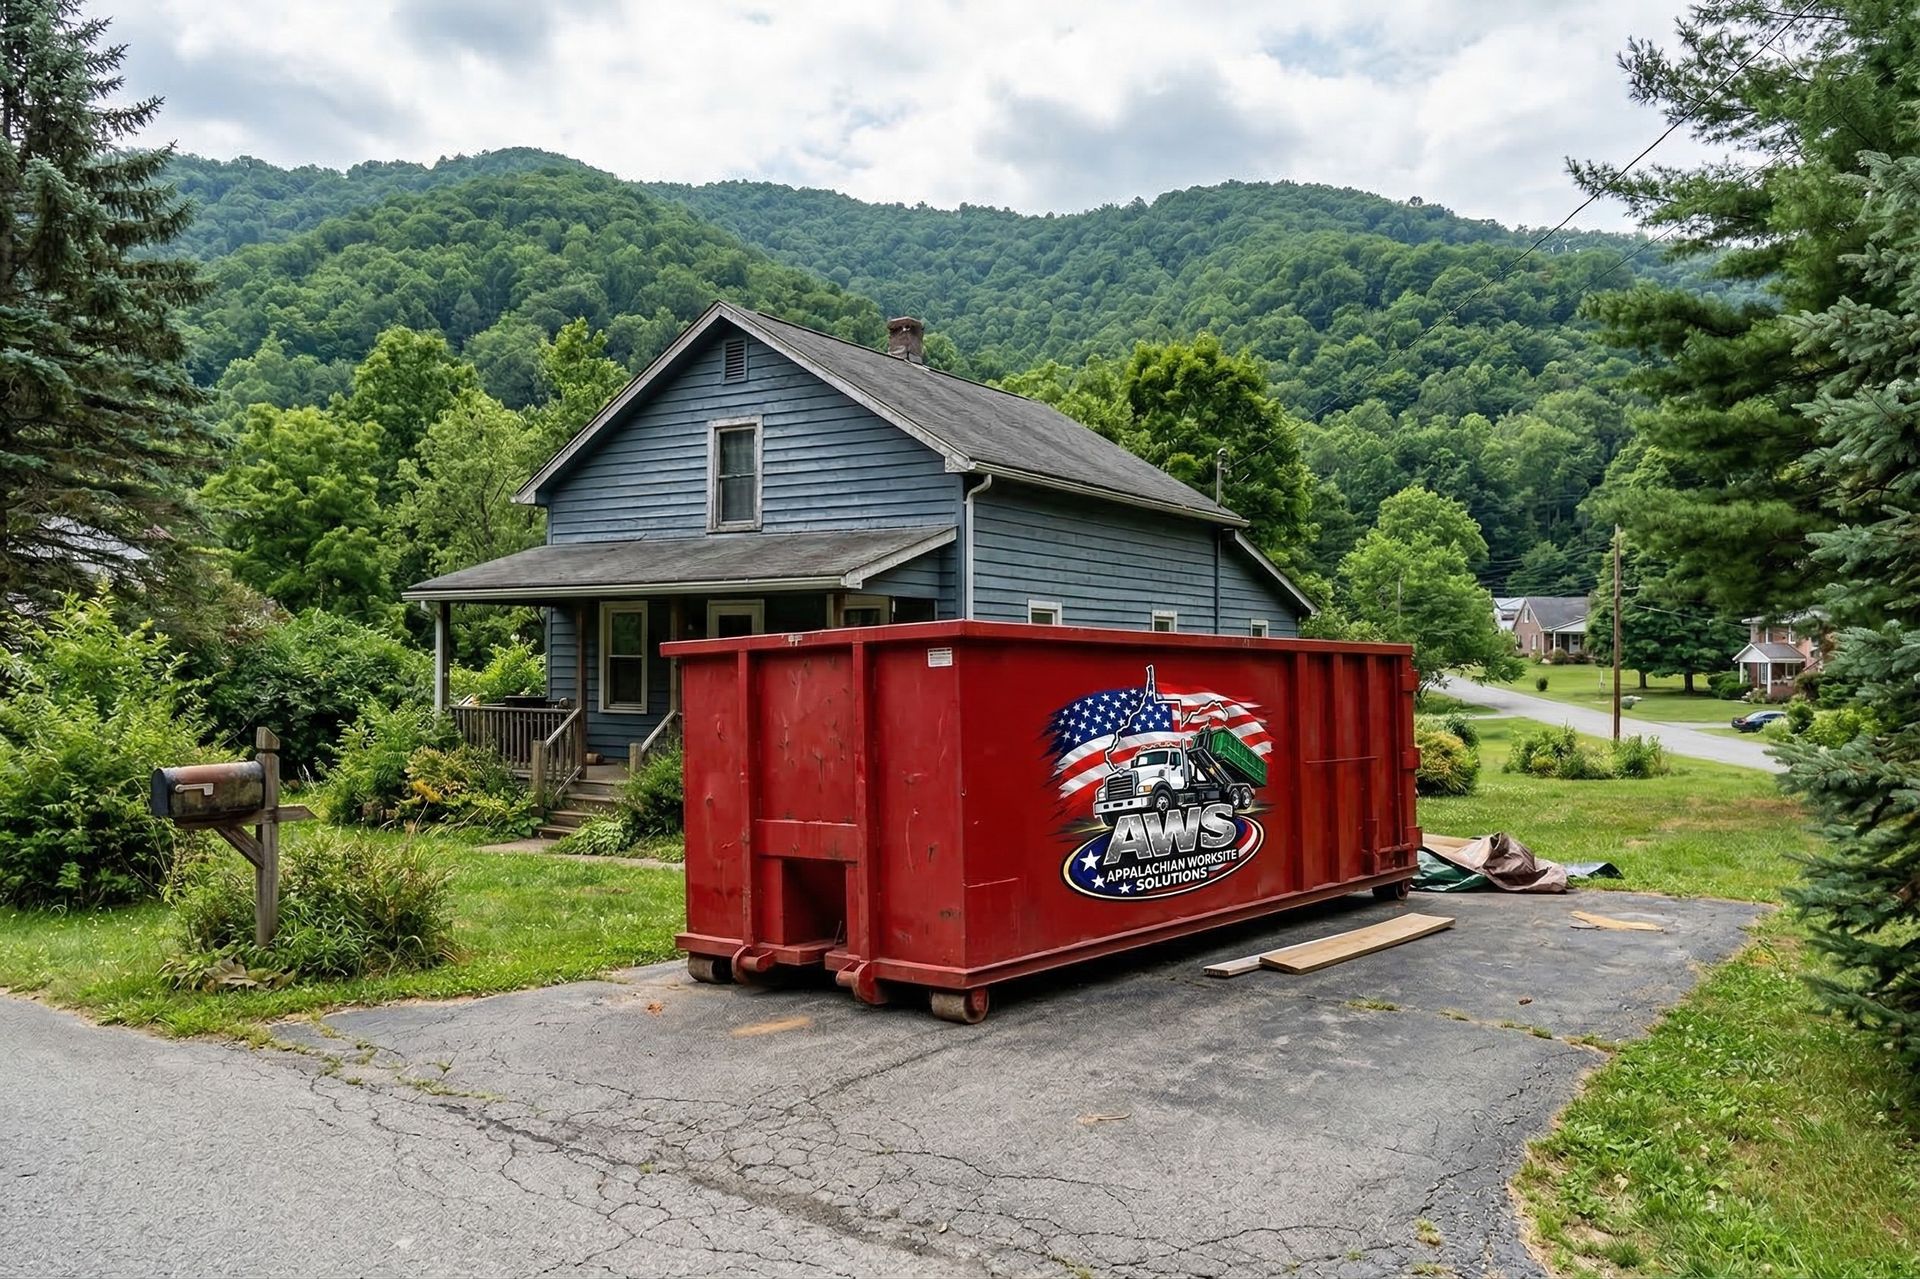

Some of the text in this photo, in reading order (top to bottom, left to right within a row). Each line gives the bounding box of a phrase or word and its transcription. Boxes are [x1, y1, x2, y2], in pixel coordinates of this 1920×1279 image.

[1103, 803, 1236, 865] AWS
[1106, 849, 1237, 882] APPALACHIAN WORKSITE
[1136, 868, 1207, 891] SOLUTIONS
